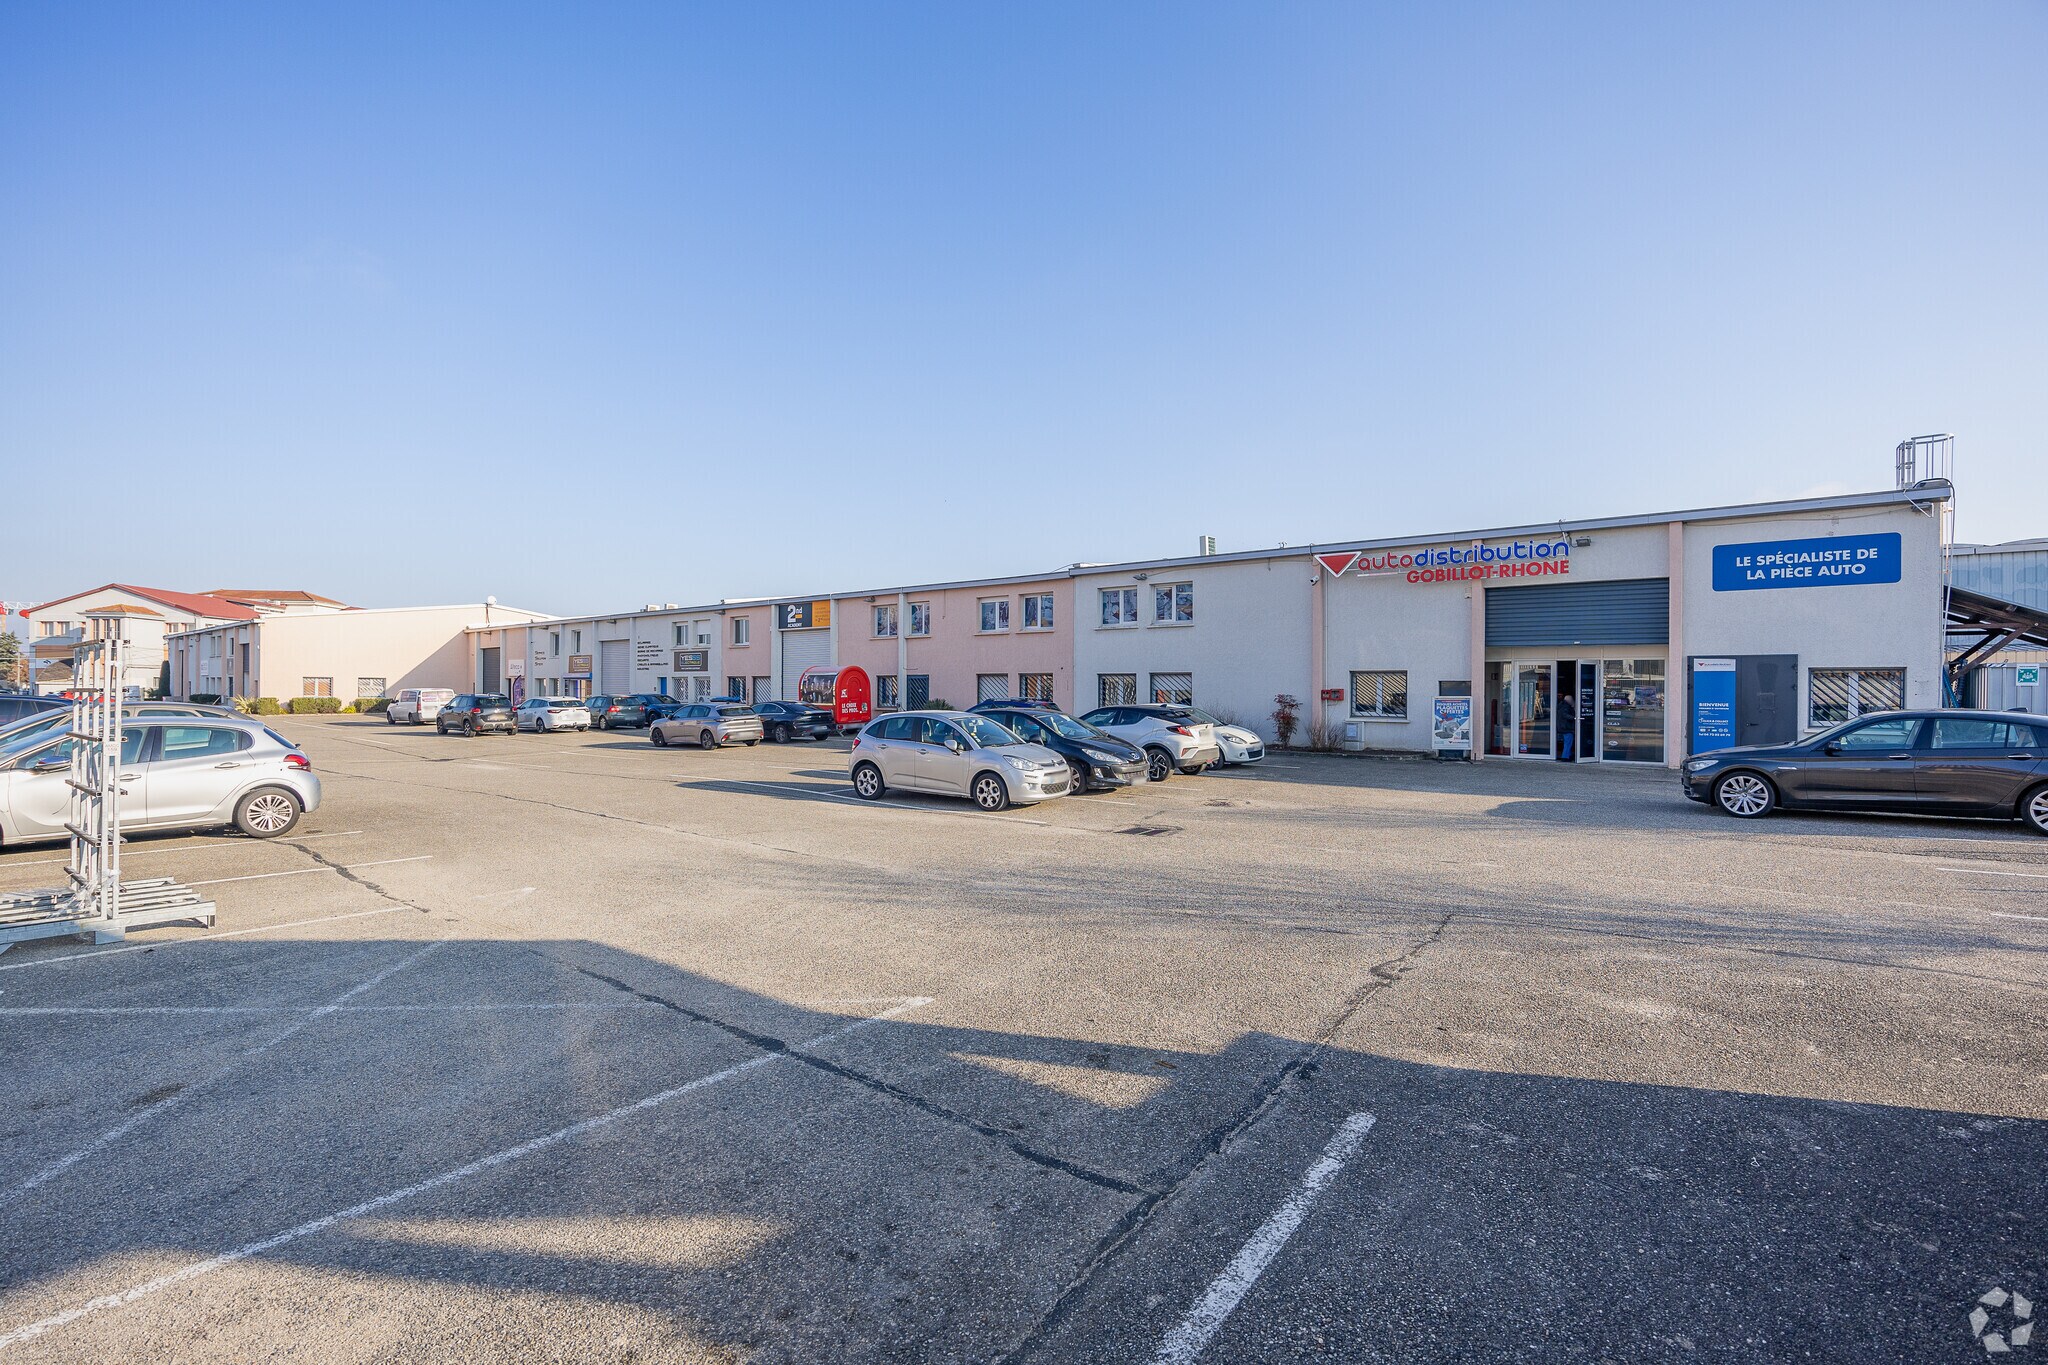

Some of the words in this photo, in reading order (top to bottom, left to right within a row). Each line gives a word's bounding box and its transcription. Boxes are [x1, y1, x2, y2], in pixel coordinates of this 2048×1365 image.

[1358, 540, 1568, 571] autodistribution
[1736, 556, 1750, 566] LE
[1757, 550, 1850, 566] SPÉCIALISTE
[1857, 548, 1877, 560] DE
[1407, 560, 1569, 583] GOBILLOT-RHONE
[1747, 569, 1765, 580] LA
[1771, 565, 1812, 578] PIÈCE
[1818, 564, 1866, 576] AUTO
[788, 605, 802, 623] 2nd
